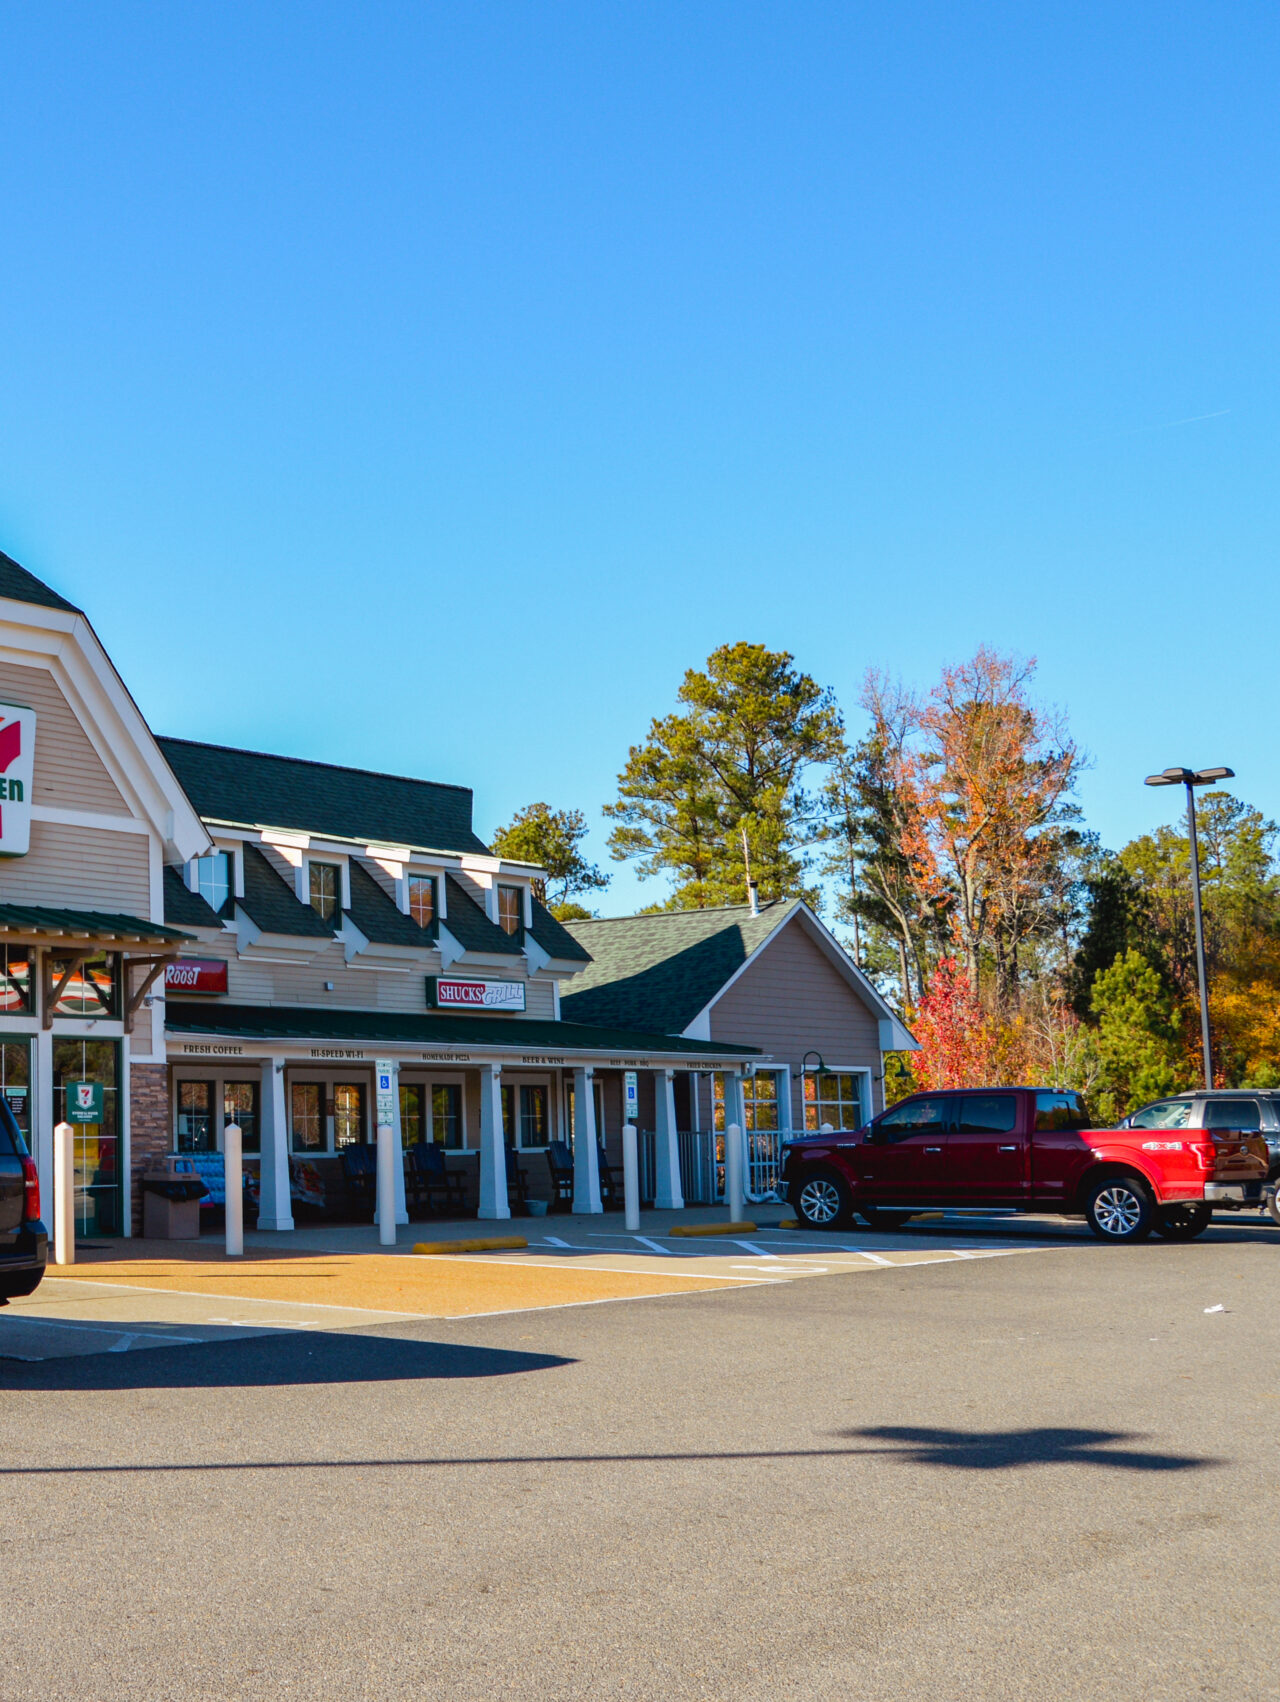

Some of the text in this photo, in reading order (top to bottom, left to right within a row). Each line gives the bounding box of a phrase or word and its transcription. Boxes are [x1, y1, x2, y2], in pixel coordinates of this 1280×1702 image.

[166, 965, 201, 985] ROOST
[440, 984, 522, 1005] SHUCKS' GRILL
[183, 1044, 243, 1055] FRESH COFFEE
[311, 1049, 364, 1059] HI-SPEED WI-FI
[422, 1053, 471, 1062] HOMEMADE PIZZA
[522, 1056, 540, 1064] BEER
[547, 1057, 564, 1065] WINE
